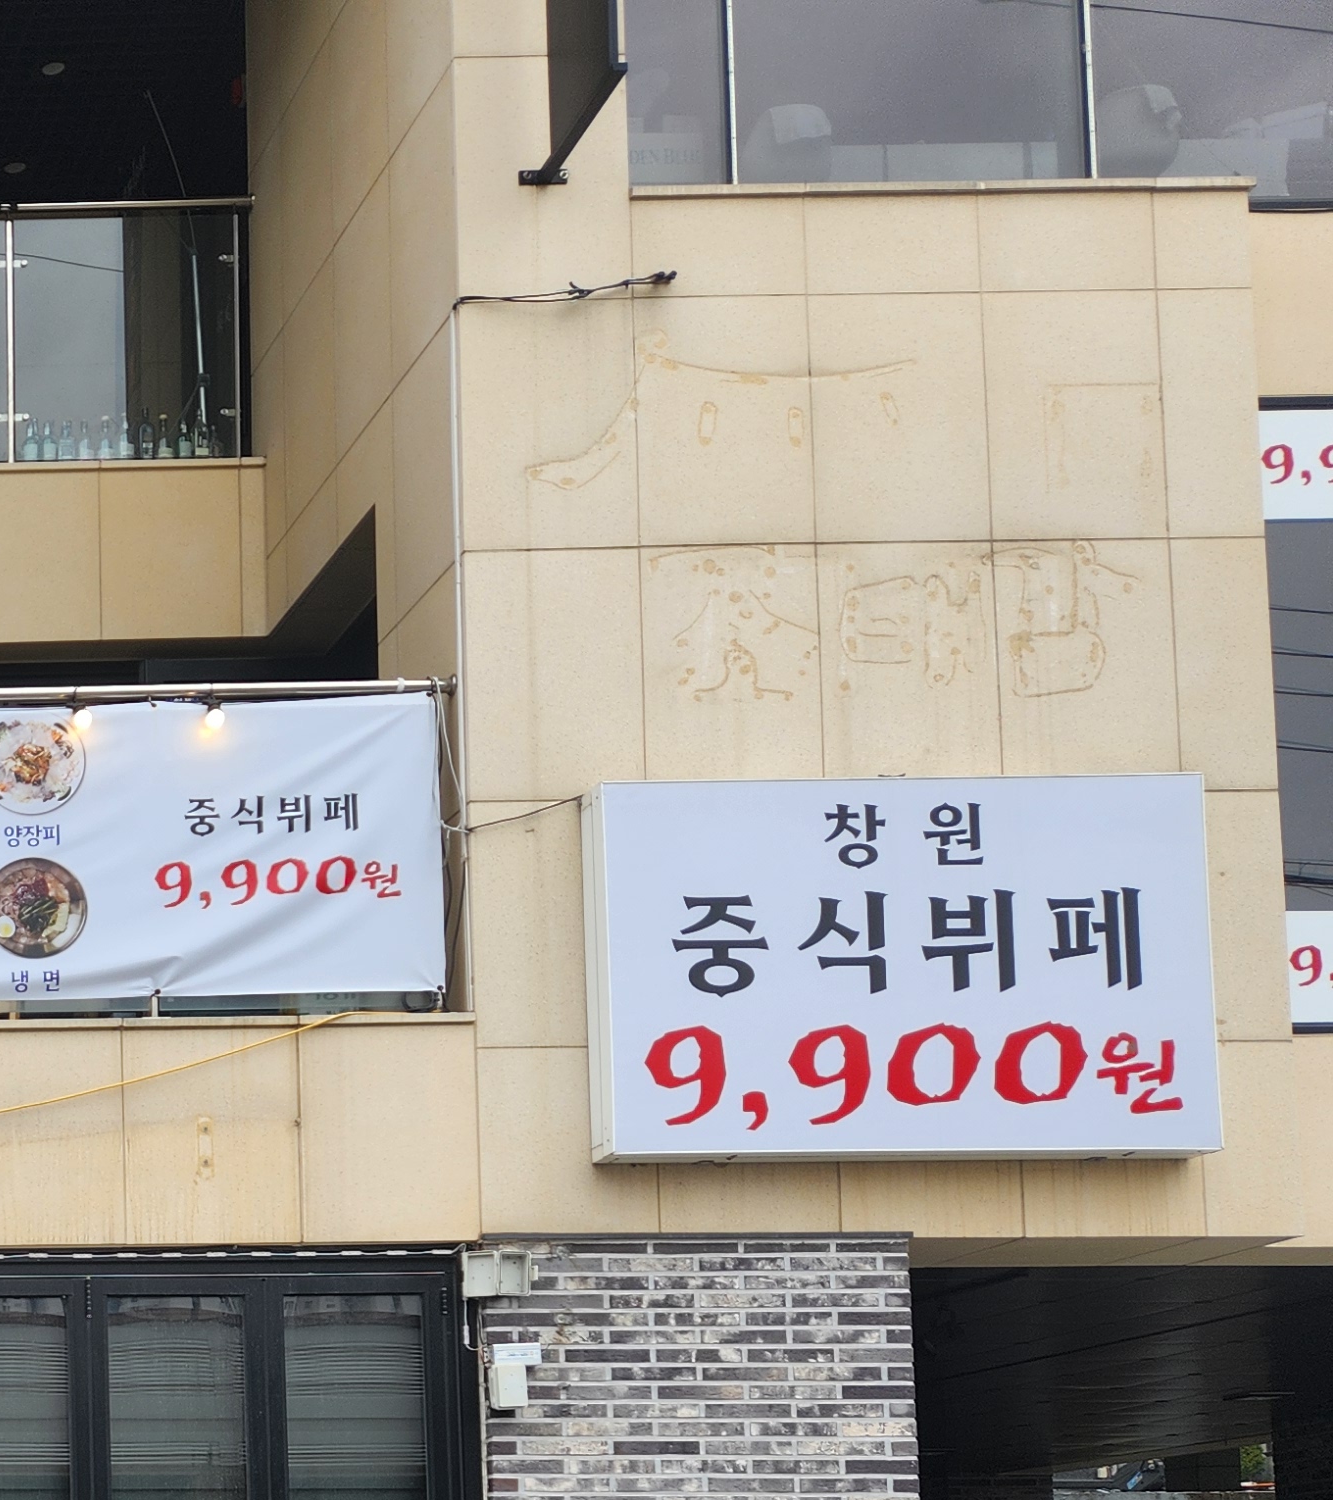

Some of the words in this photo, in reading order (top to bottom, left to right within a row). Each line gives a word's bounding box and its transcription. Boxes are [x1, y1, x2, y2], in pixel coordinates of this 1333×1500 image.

[3, 824, 61, 848] 양장피
[184, 792, 360, 837] 중식뷔페
[823, 802, 985, 869] 창원
[154, 856, 402, 909] 9,900원
[671, 886, 1143, 998] 중식뷔페
[644, 1021, 1183, 1132] 9,900원
